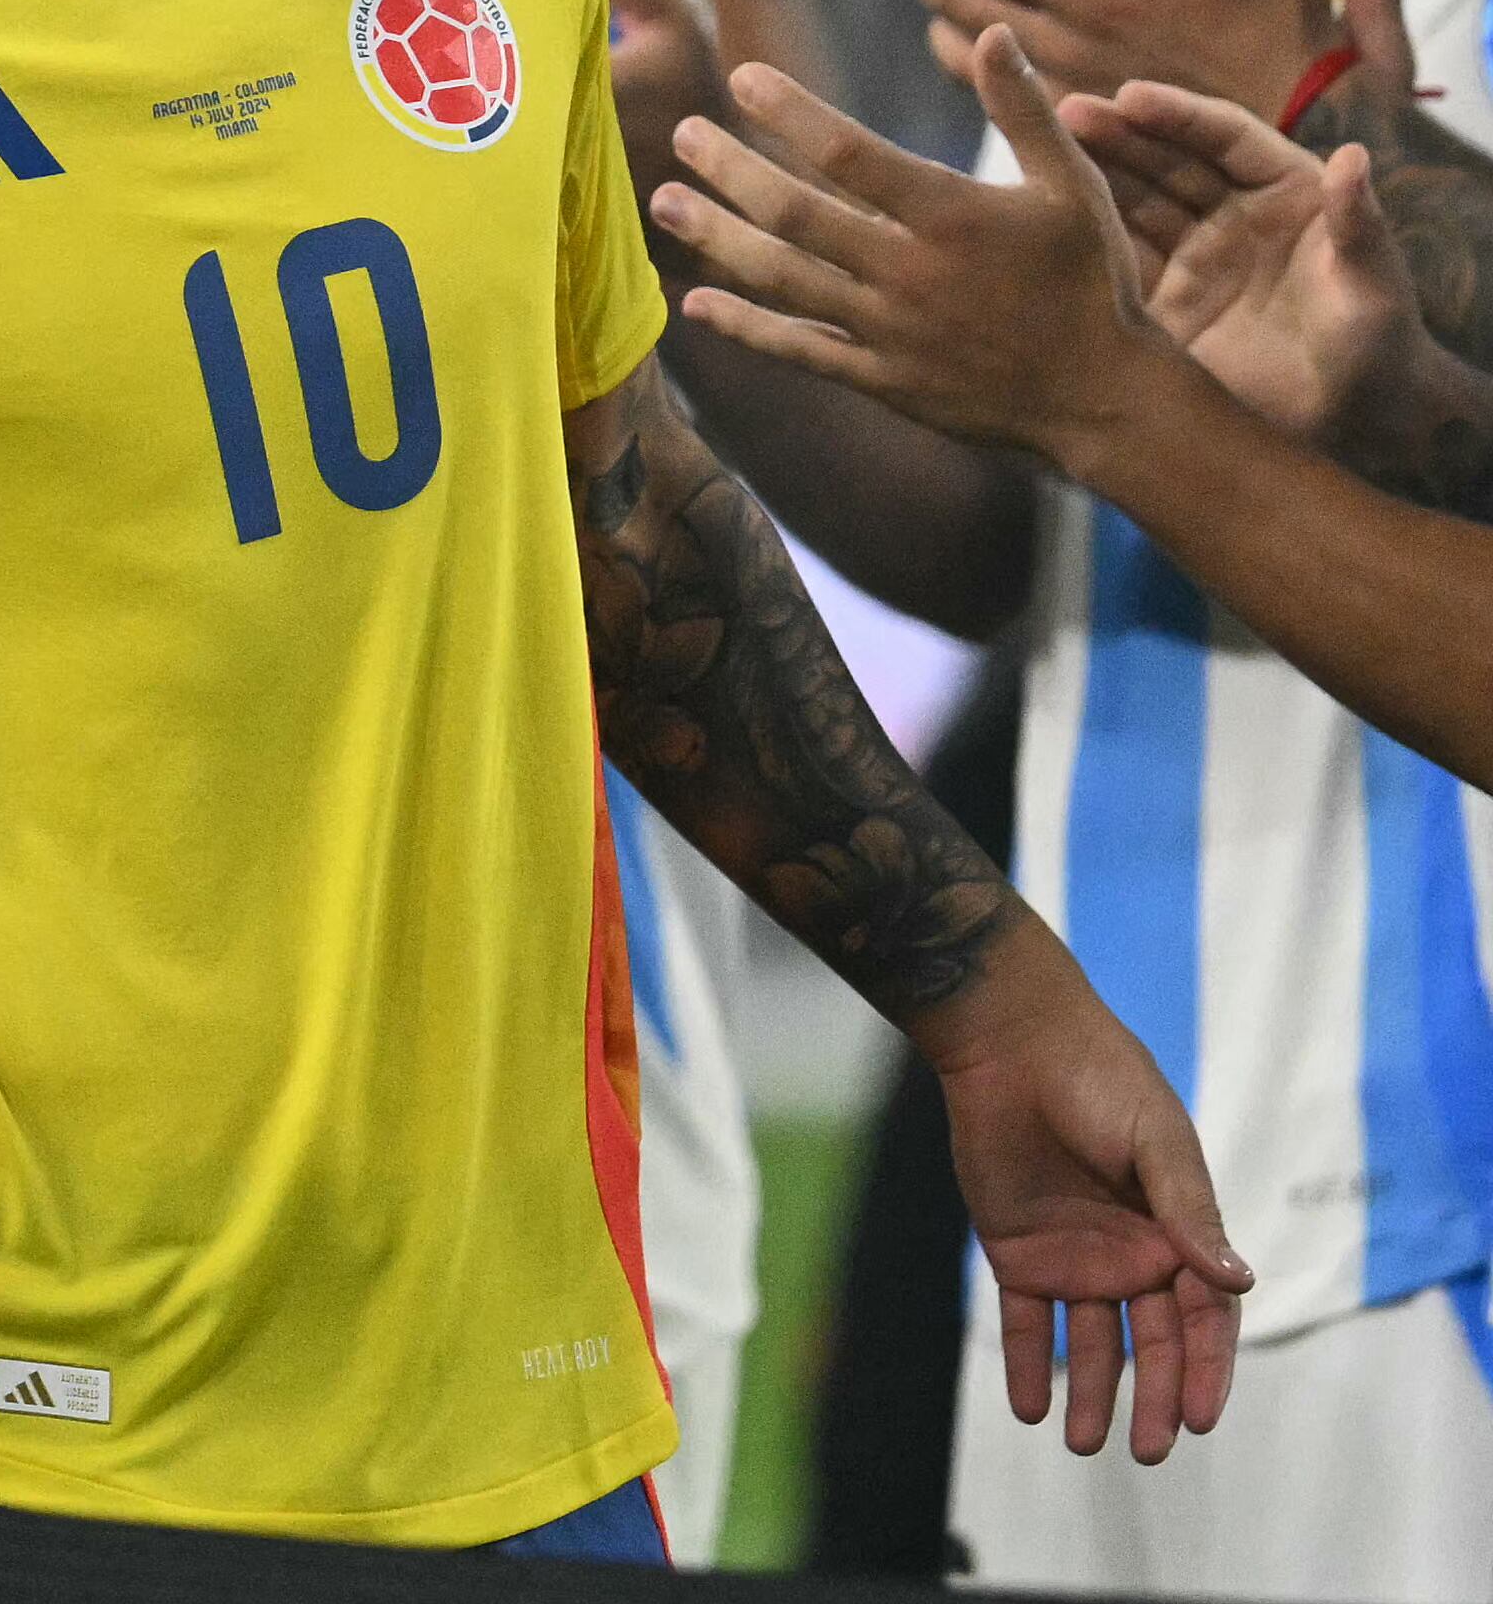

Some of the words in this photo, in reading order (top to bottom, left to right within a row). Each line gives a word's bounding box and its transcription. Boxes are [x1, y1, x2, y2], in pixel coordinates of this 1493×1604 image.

[152, 91, 220, 119] ARGENTINA
[235, 72, 296, 98] COLOMBIA
[189, 114, 204, 128] 14
[209, 107, 234, 125] JULY
[239, 98, 272, 116] 2024
[215, 117, 259, 140] MIAMI
[183, 217, 442, 545] 10
